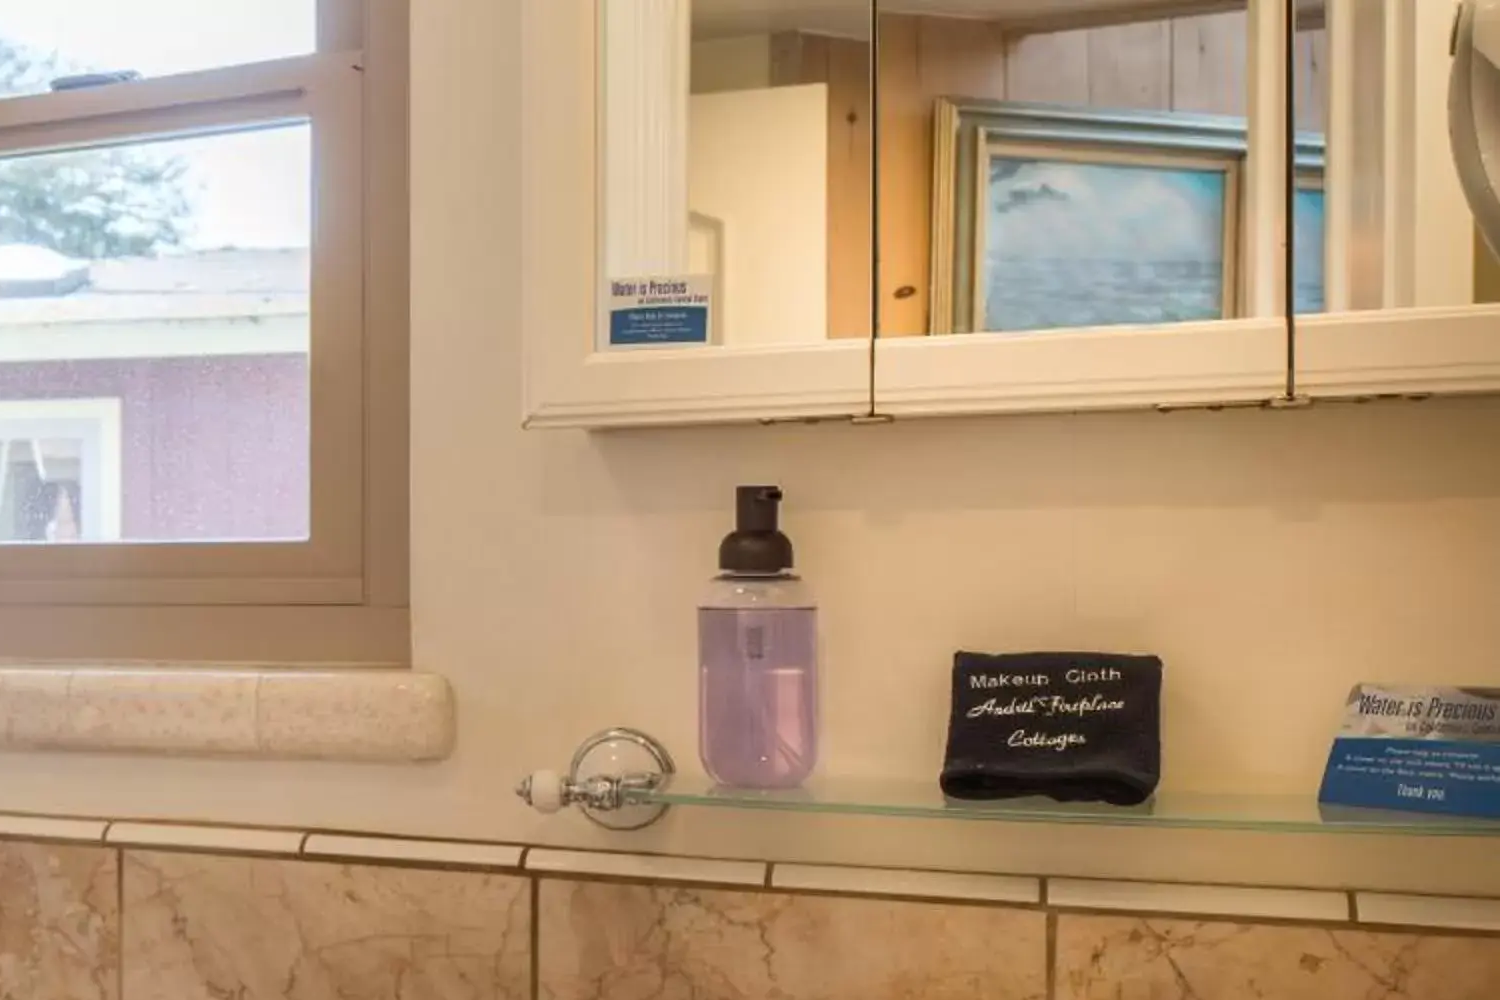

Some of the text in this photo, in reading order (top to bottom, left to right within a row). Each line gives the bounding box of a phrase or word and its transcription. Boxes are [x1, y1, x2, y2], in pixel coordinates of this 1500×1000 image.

[969, 668, 1122, 689] Makeup Cloth
[1358, 694, 1496, 720] Water is Precious
[1007, 729, 1087, 751] Cottages
